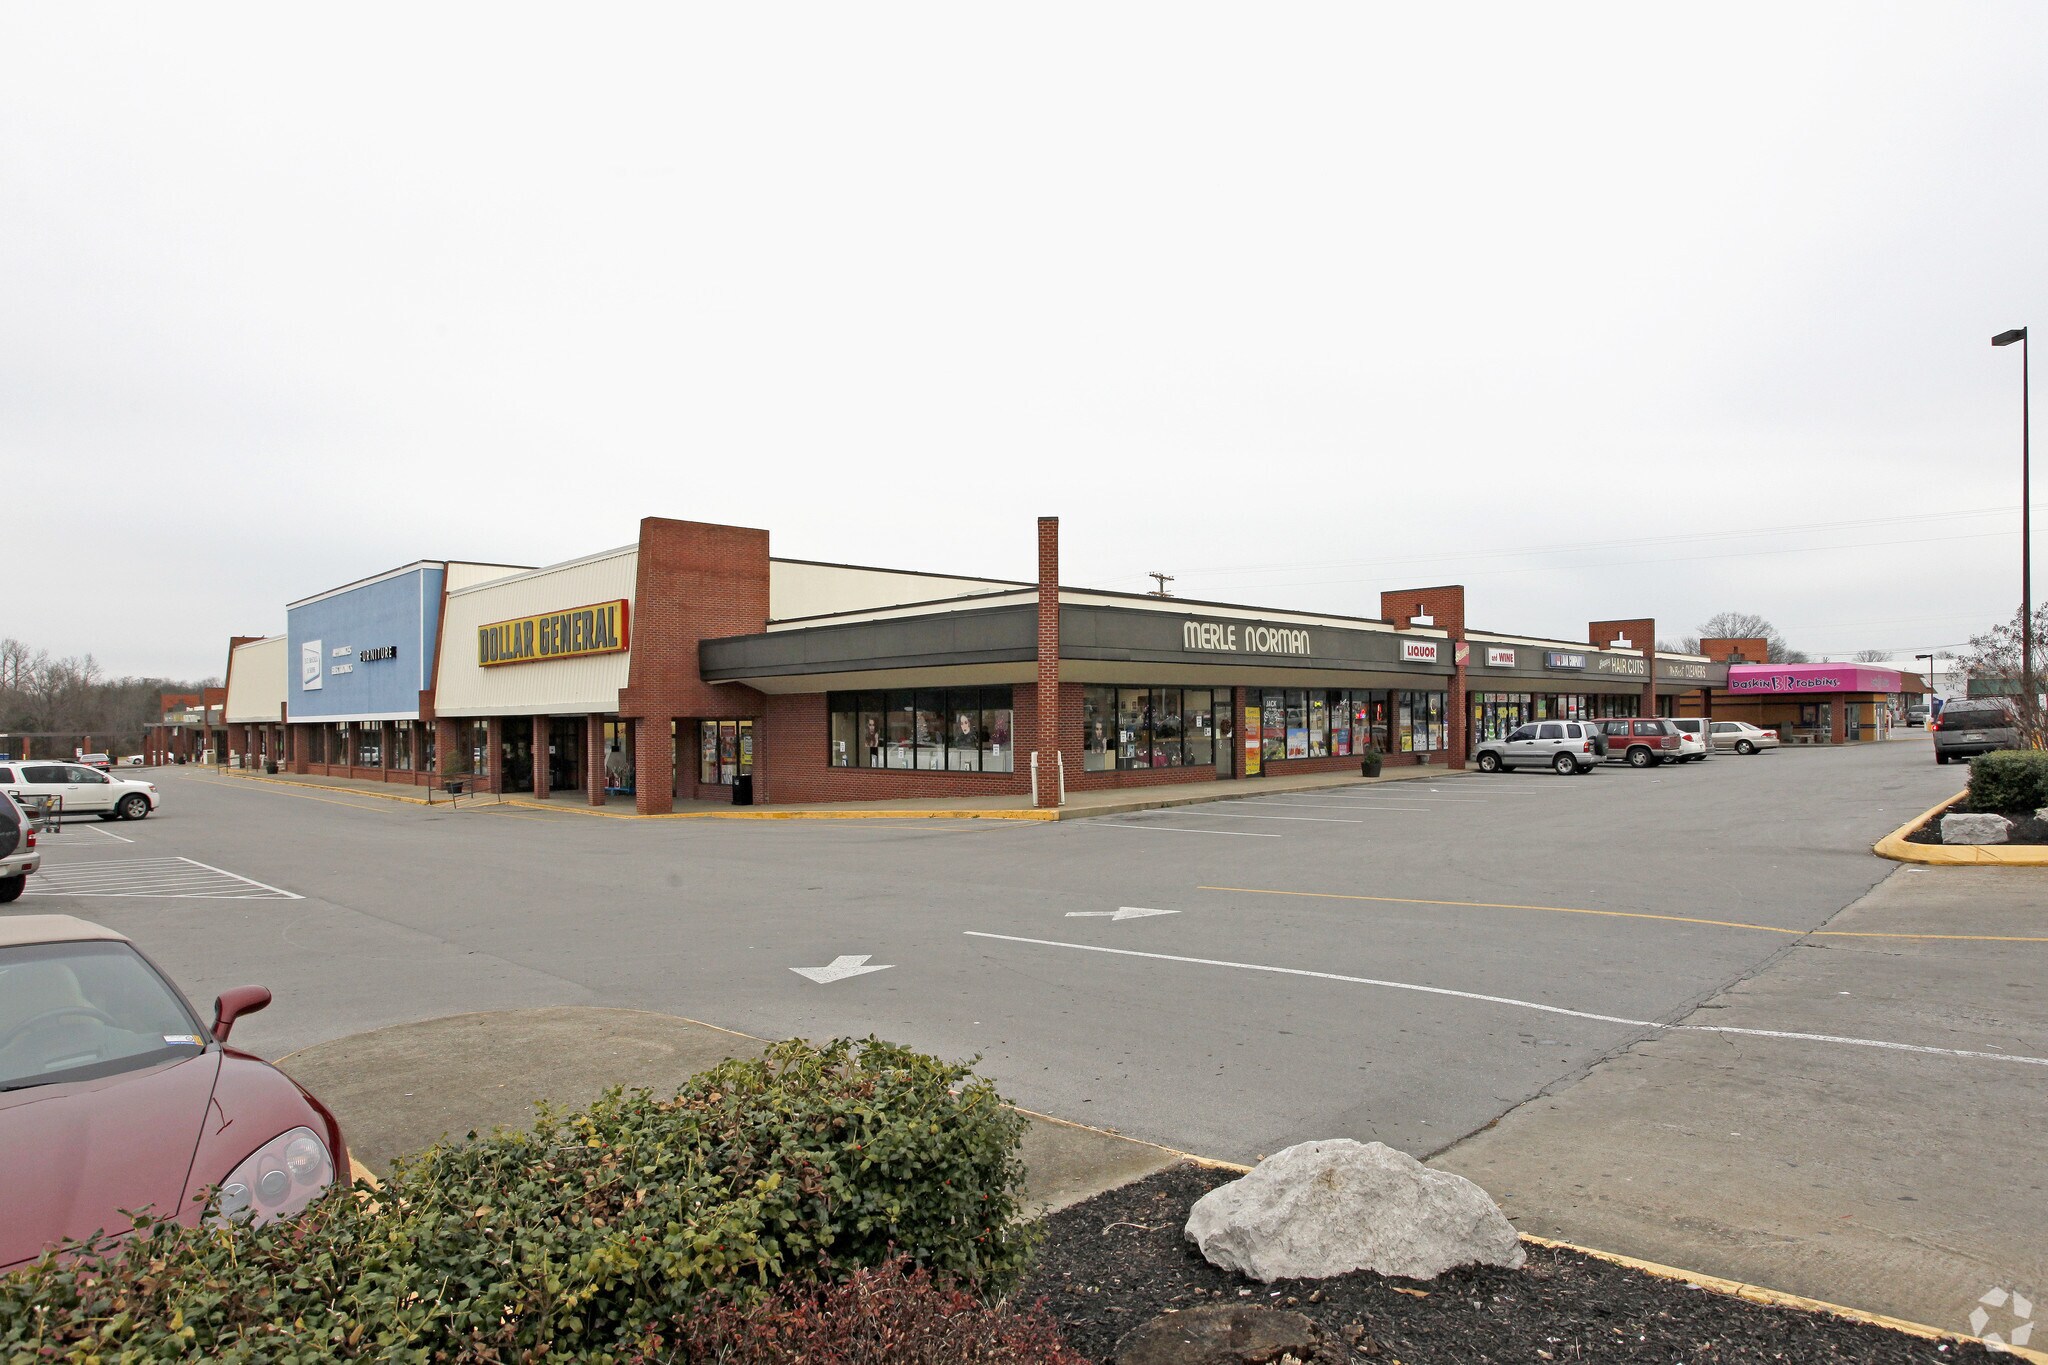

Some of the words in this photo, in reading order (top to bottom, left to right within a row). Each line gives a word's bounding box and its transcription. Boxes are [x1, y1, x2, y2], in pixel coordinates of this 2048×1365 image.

[479, 620, 535, 663] DOLLAR
[539, 606, 618, 655] GENERAL
[1183, 620, 1236, 651] MERLE
[1245, 625, 1311, 655] NORMAN
[359, 646, 392, 662] FURNITURE
[1407, 645, 1435, 658] LIQUOR
[1499, 652, 1514, 663] WINE
[1611, 657, 1627, 673] HAIR
[1627, 659, 1644, 674] CUTS
[1685, 664, 1706, 679] CLEANERS
